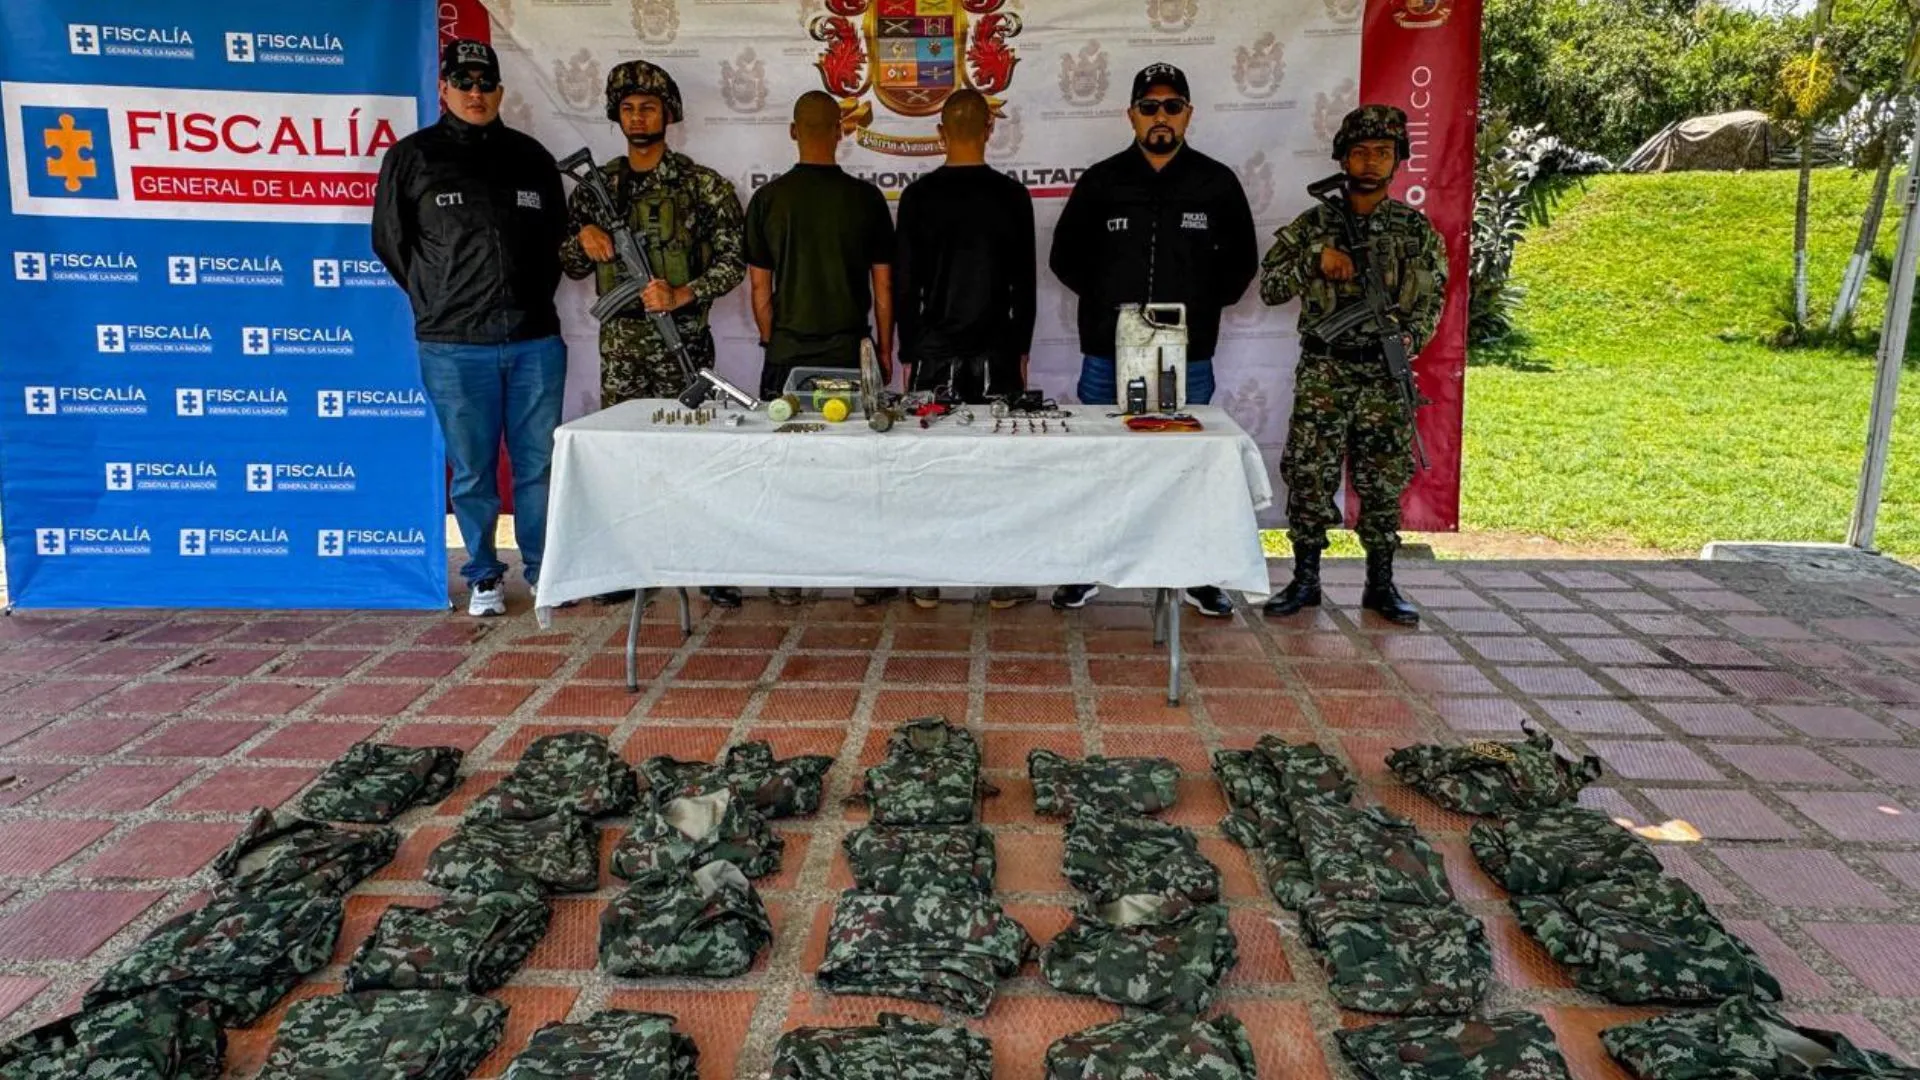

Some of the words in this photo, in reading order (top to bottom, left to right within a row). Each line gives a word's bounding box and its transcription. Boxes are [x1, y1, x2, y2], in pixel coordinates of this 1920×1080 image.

[102, 26, 193, 44] FISCALÍA
[257, 33, 343, 50] FISCALÍA
[126, 108, 401, 157] FISCALÍA
[1406, 66, 1431, 214] o.mil.co
[140, 175, 248, 197] GENERAL
[252, 179, 282, 198] DE
[289, 180, 316, 199] LA
[320, 181, 378, 200] NACI
[435, 191, 464, 207] CTI
[1107, 217, 1129, 232] CTI
[50, 252, 138, 268] FISCALÍA
[199, 255, 283, 271] FISCALÍA
[343, 260, 387, 273] FISC
[127, 324, 212, 340] FISCALÍA
[272, 326, 354, 342] FISCALÍA
[60, 385, 146, 401] FISCALÍA
[206, 387, 288, 403] FISCALÍA
[346, 389, 426, 404] FISCALÍA
[136, 461, 217, 476] FISCALÍA
[276, 462, 355, 477] FISCALÍA
[69, 526, 151, 541] FISCALÍA
[209, 527, 289, 542] FISCALÍA
[347, 528, 426, 543] FISCALÍA
